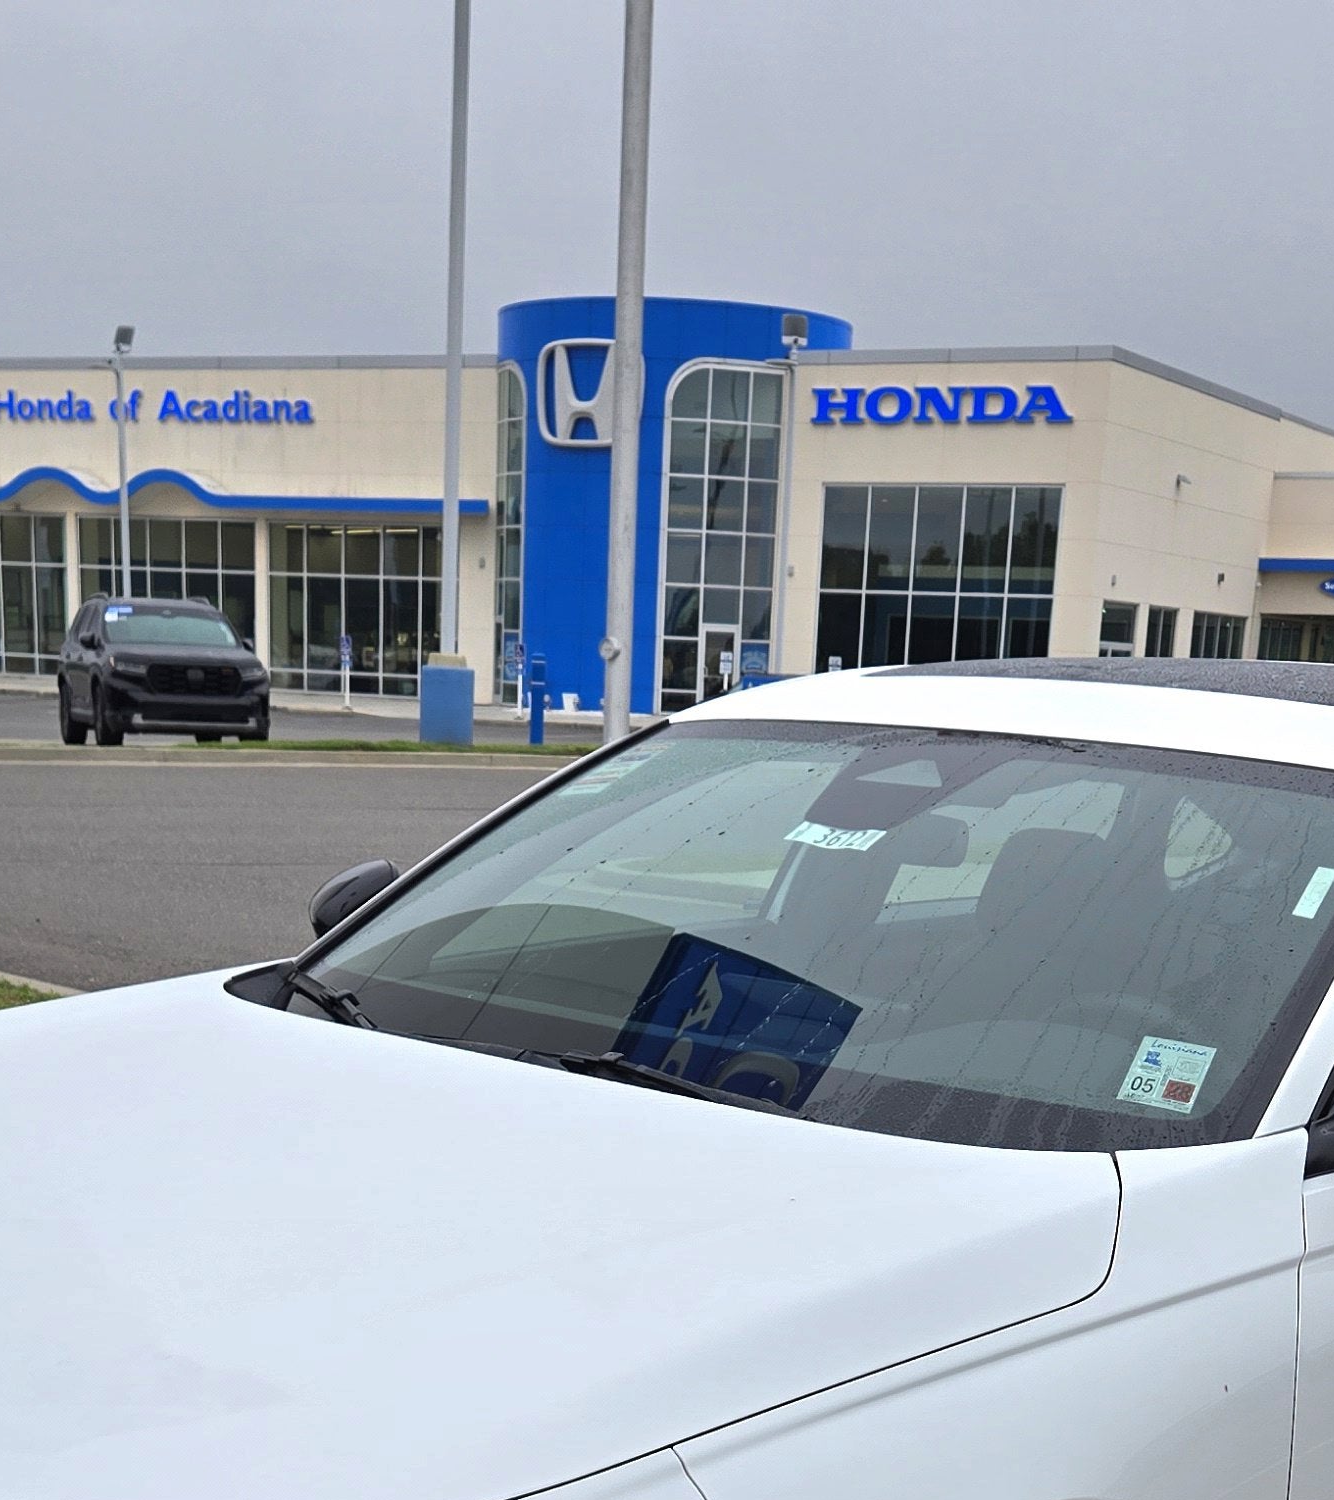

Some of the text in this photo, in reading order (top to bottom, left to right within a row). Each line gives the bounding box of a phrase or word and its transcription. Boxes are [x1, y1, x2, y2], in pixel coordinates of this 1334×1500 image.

[108, 389, 142, 421] of
[157, 389, 314, 423] Acadiana
[811, 385, 1073, 425] HONDA
[1150, 1039, 1208, 1057] Louisiana
[1130, 1075, 1156, 1094] 05
